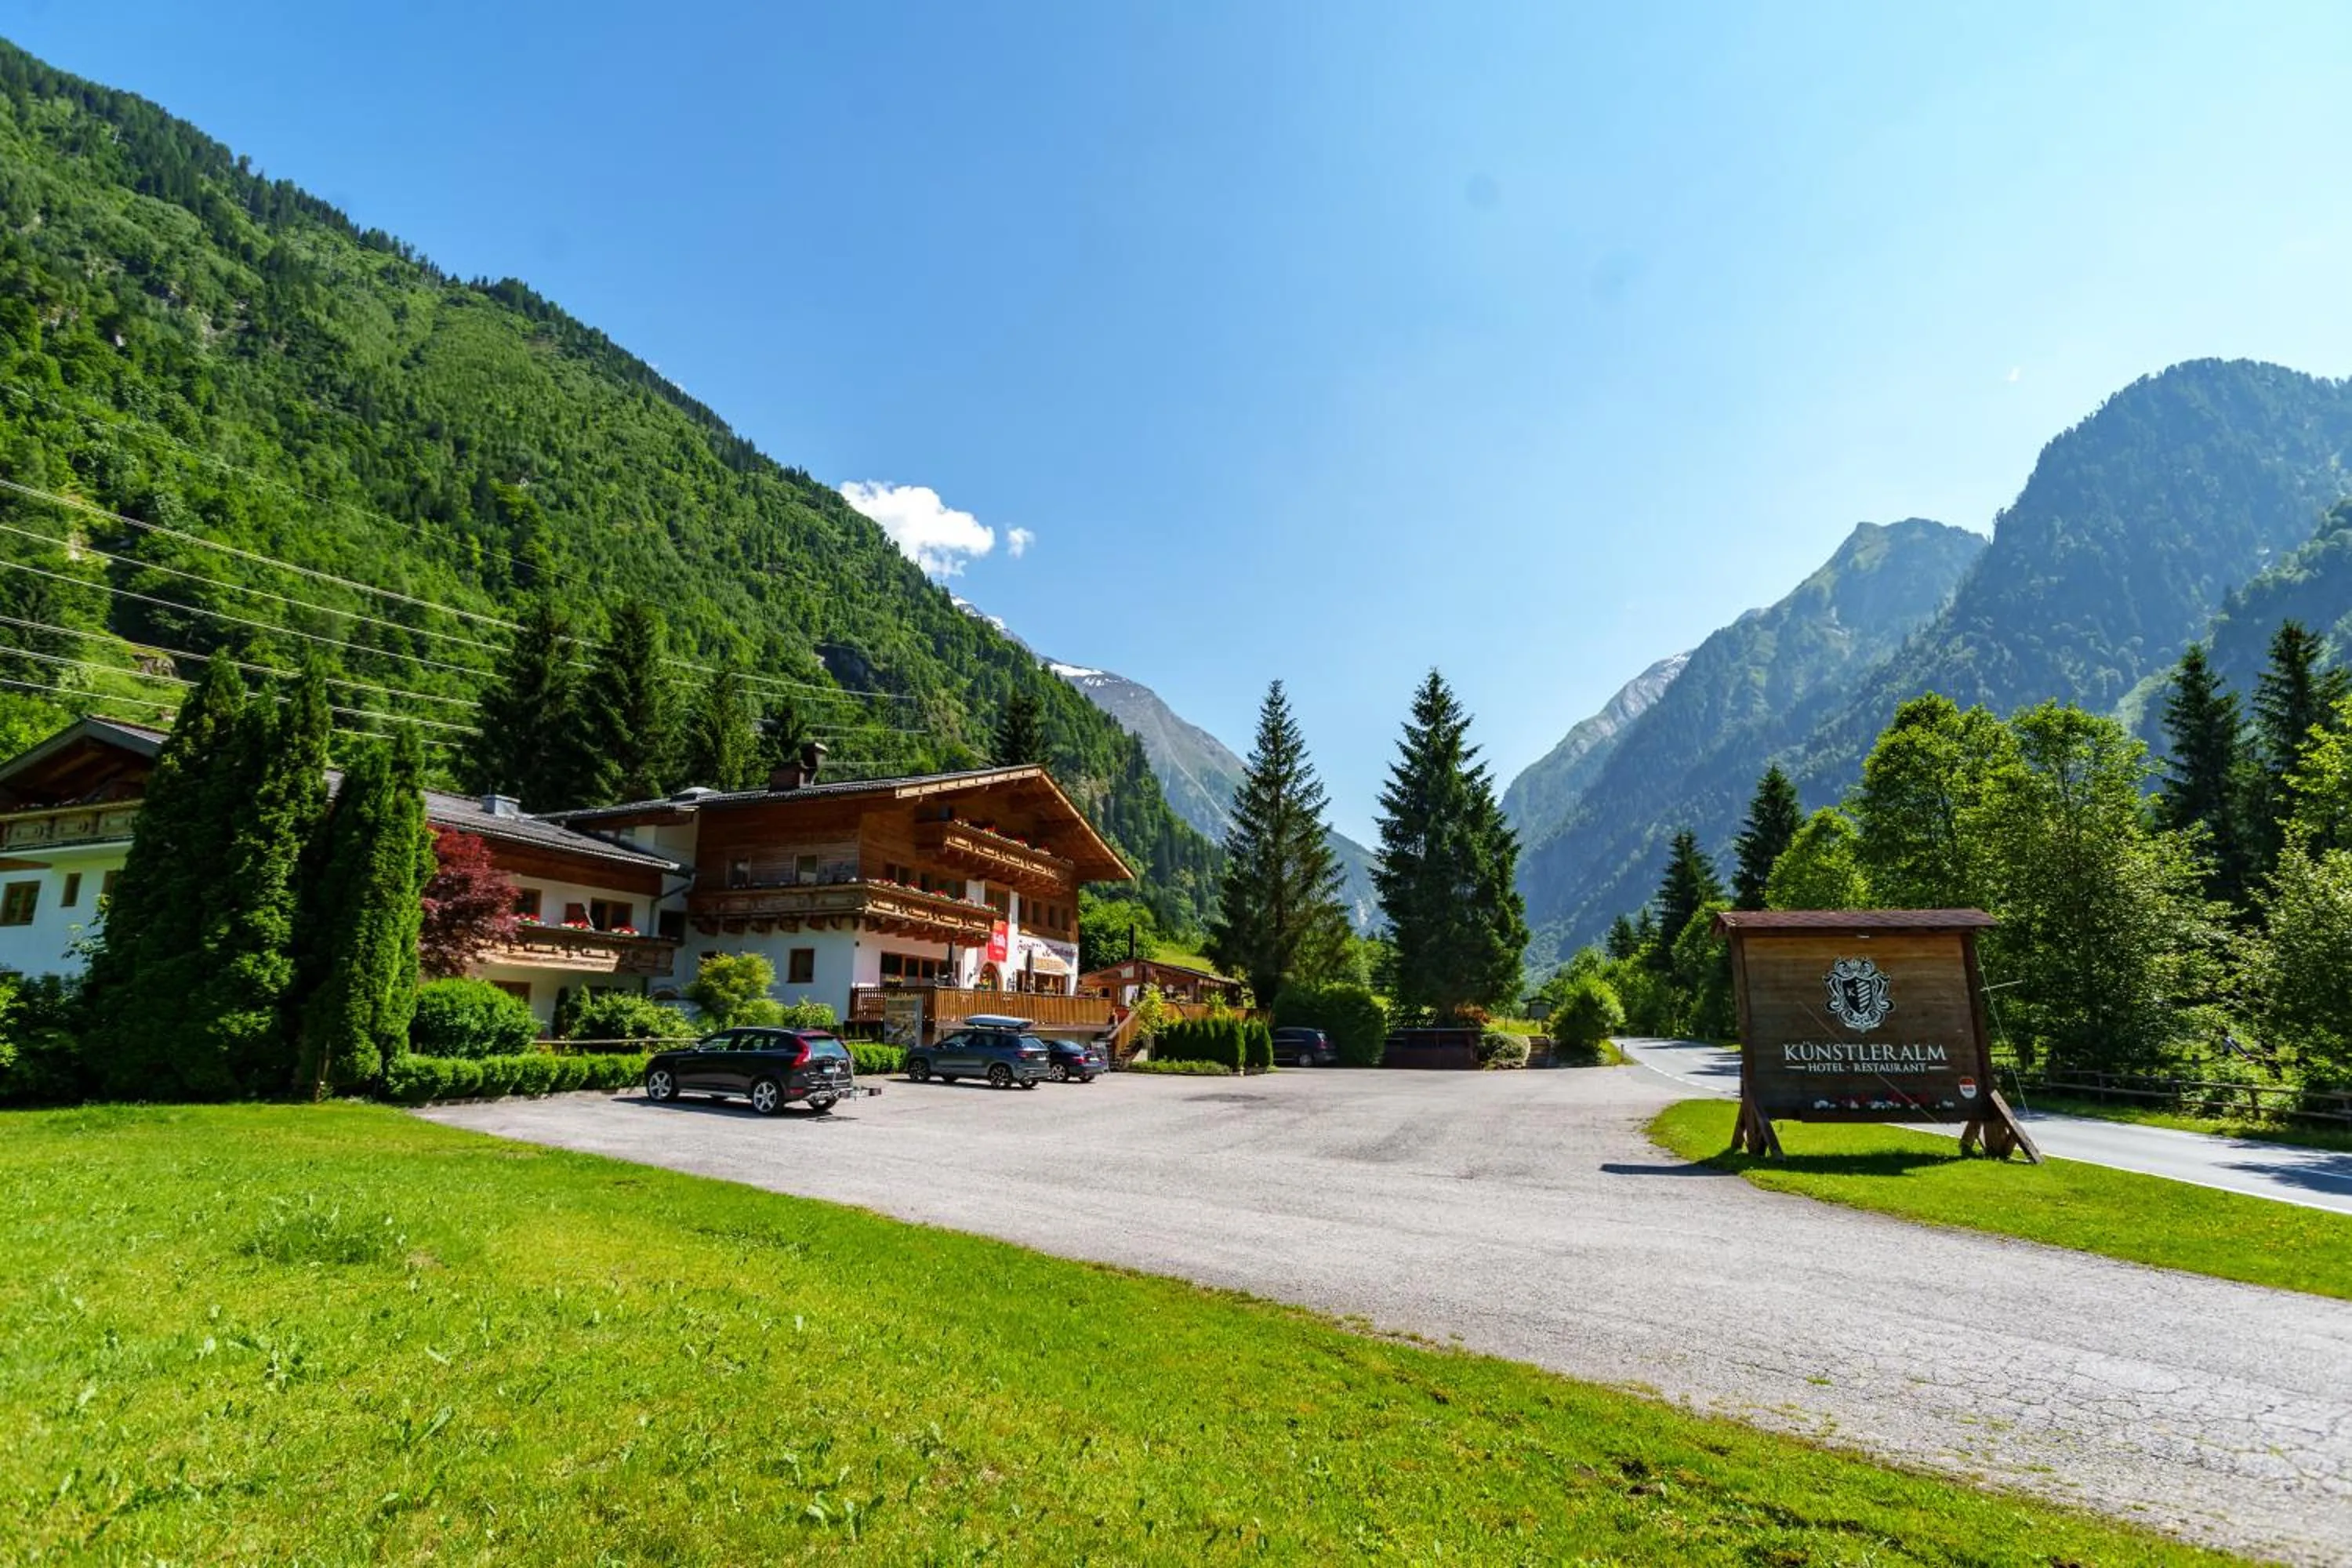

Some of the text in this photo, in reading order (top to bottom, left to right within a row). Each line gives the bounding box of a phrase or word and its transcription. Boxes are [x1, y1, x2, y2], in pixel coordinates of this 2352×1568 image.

[1846, 988, 1856, 996] K
[1784, 1041, 1947, 1060] KÜNSTLERALM
[1808, 1062, 1844, 1072] HOTEL
[1854, 1062, 1926, 1073] RESTAURANT
